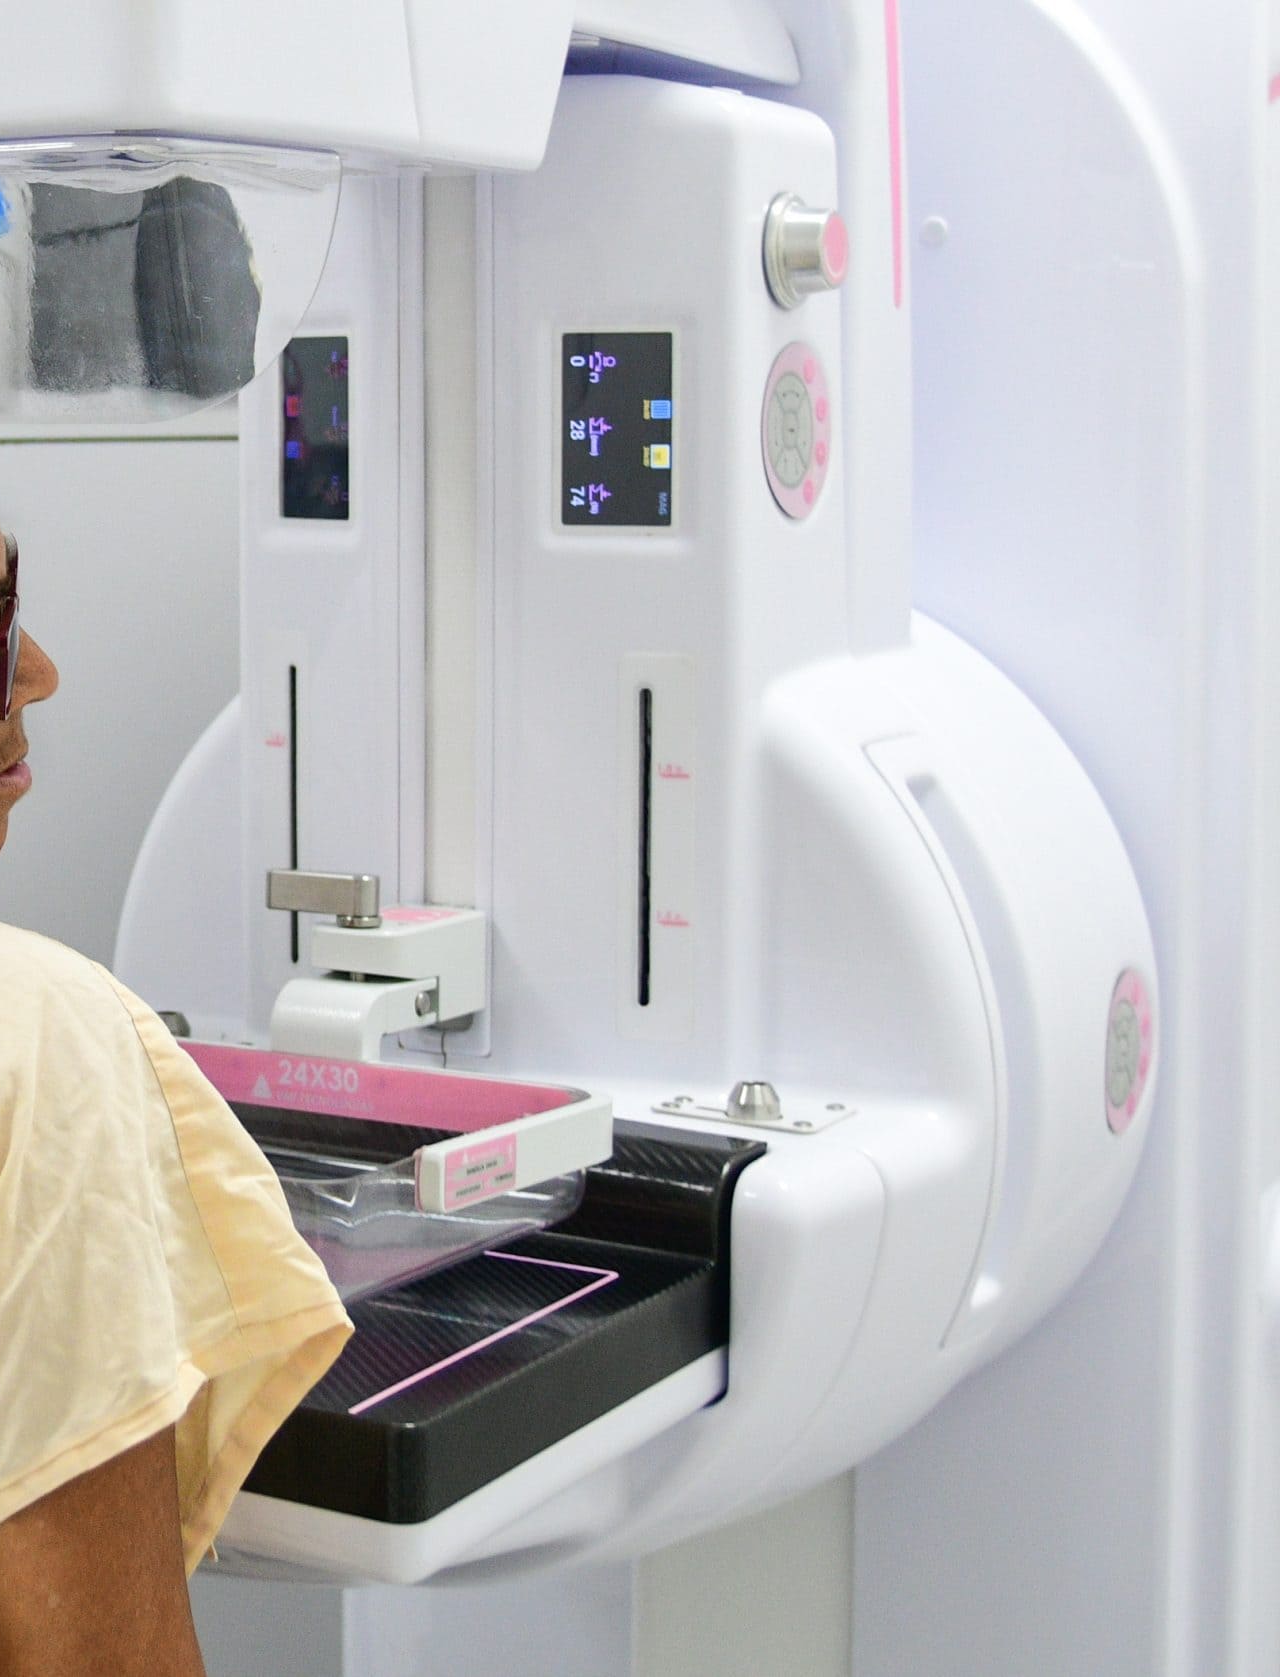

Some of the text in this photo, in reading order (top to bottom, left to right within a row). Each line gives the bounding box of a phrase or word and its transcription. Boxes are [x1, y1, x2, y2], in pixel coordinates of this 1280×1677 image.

[570, 419, 586, 441] 28
[570, 486, 586, 508] 74
[278, 1059, 360, 1095] 24X30
